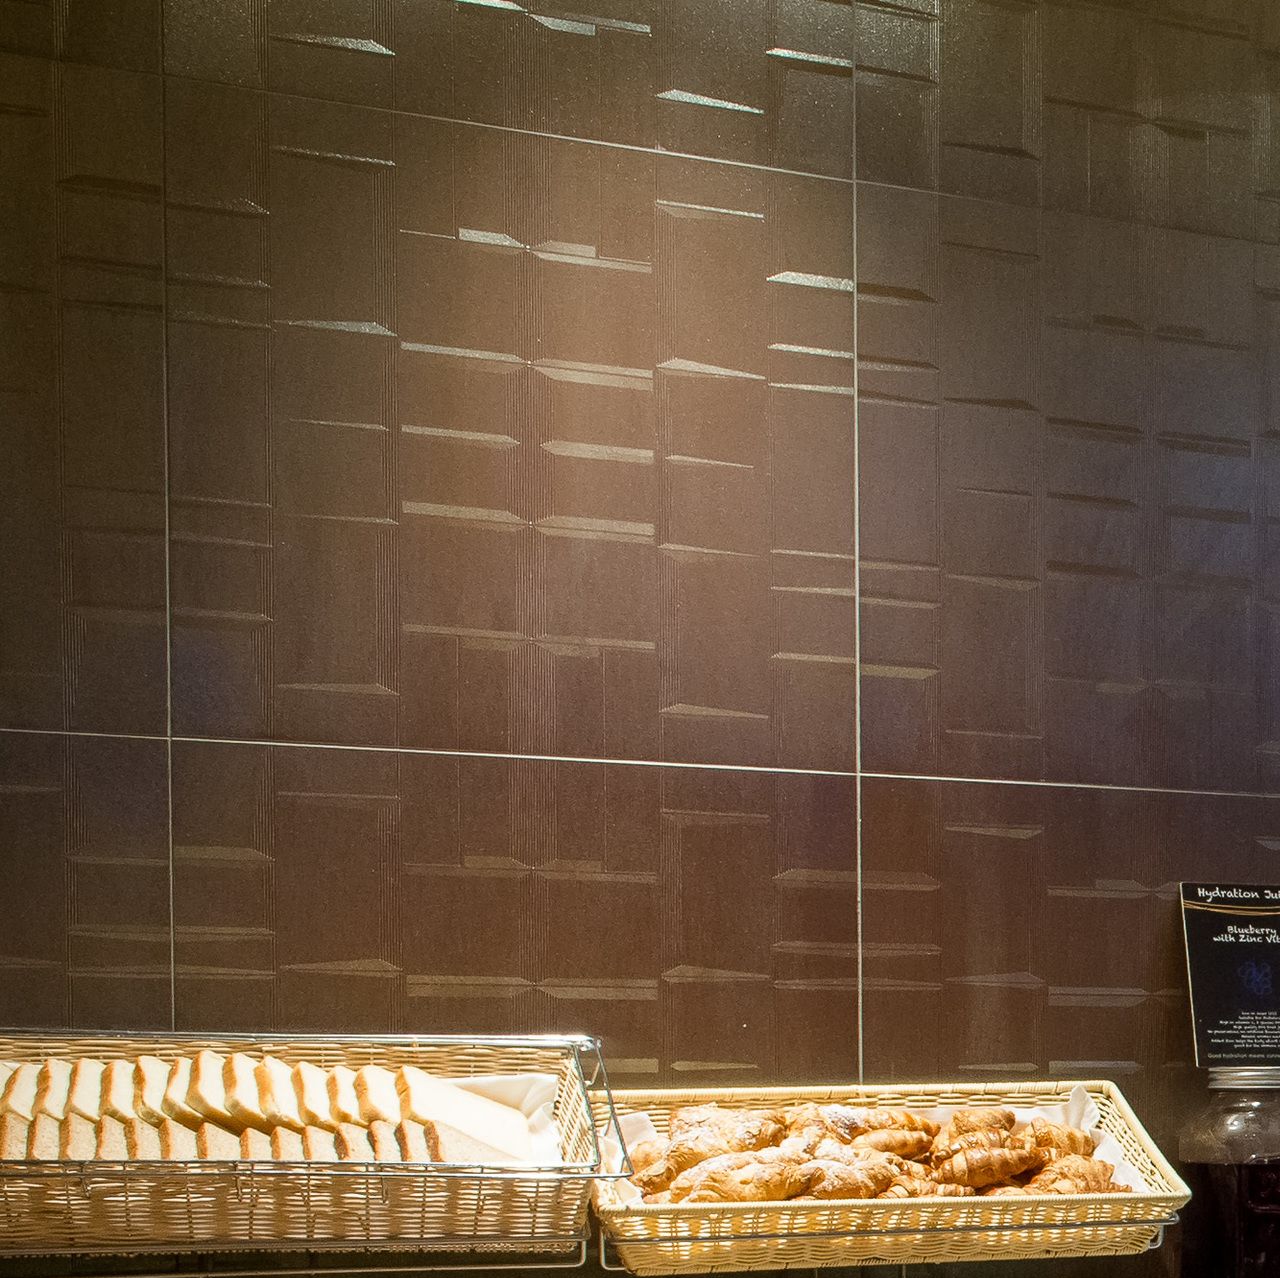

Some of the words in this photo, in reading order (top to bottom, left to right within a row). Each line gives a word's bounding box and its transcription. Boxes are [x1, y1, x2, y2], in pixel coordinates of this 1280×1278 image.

[1197, 887, 1260, 902] Hydration
[1227, 924, 1277, 938] Blueberry
[1213, 934, 1236, 943] with
[1239, 934, 1263, 943] Zinc
[1265, 935, 1280, 944] Vit
